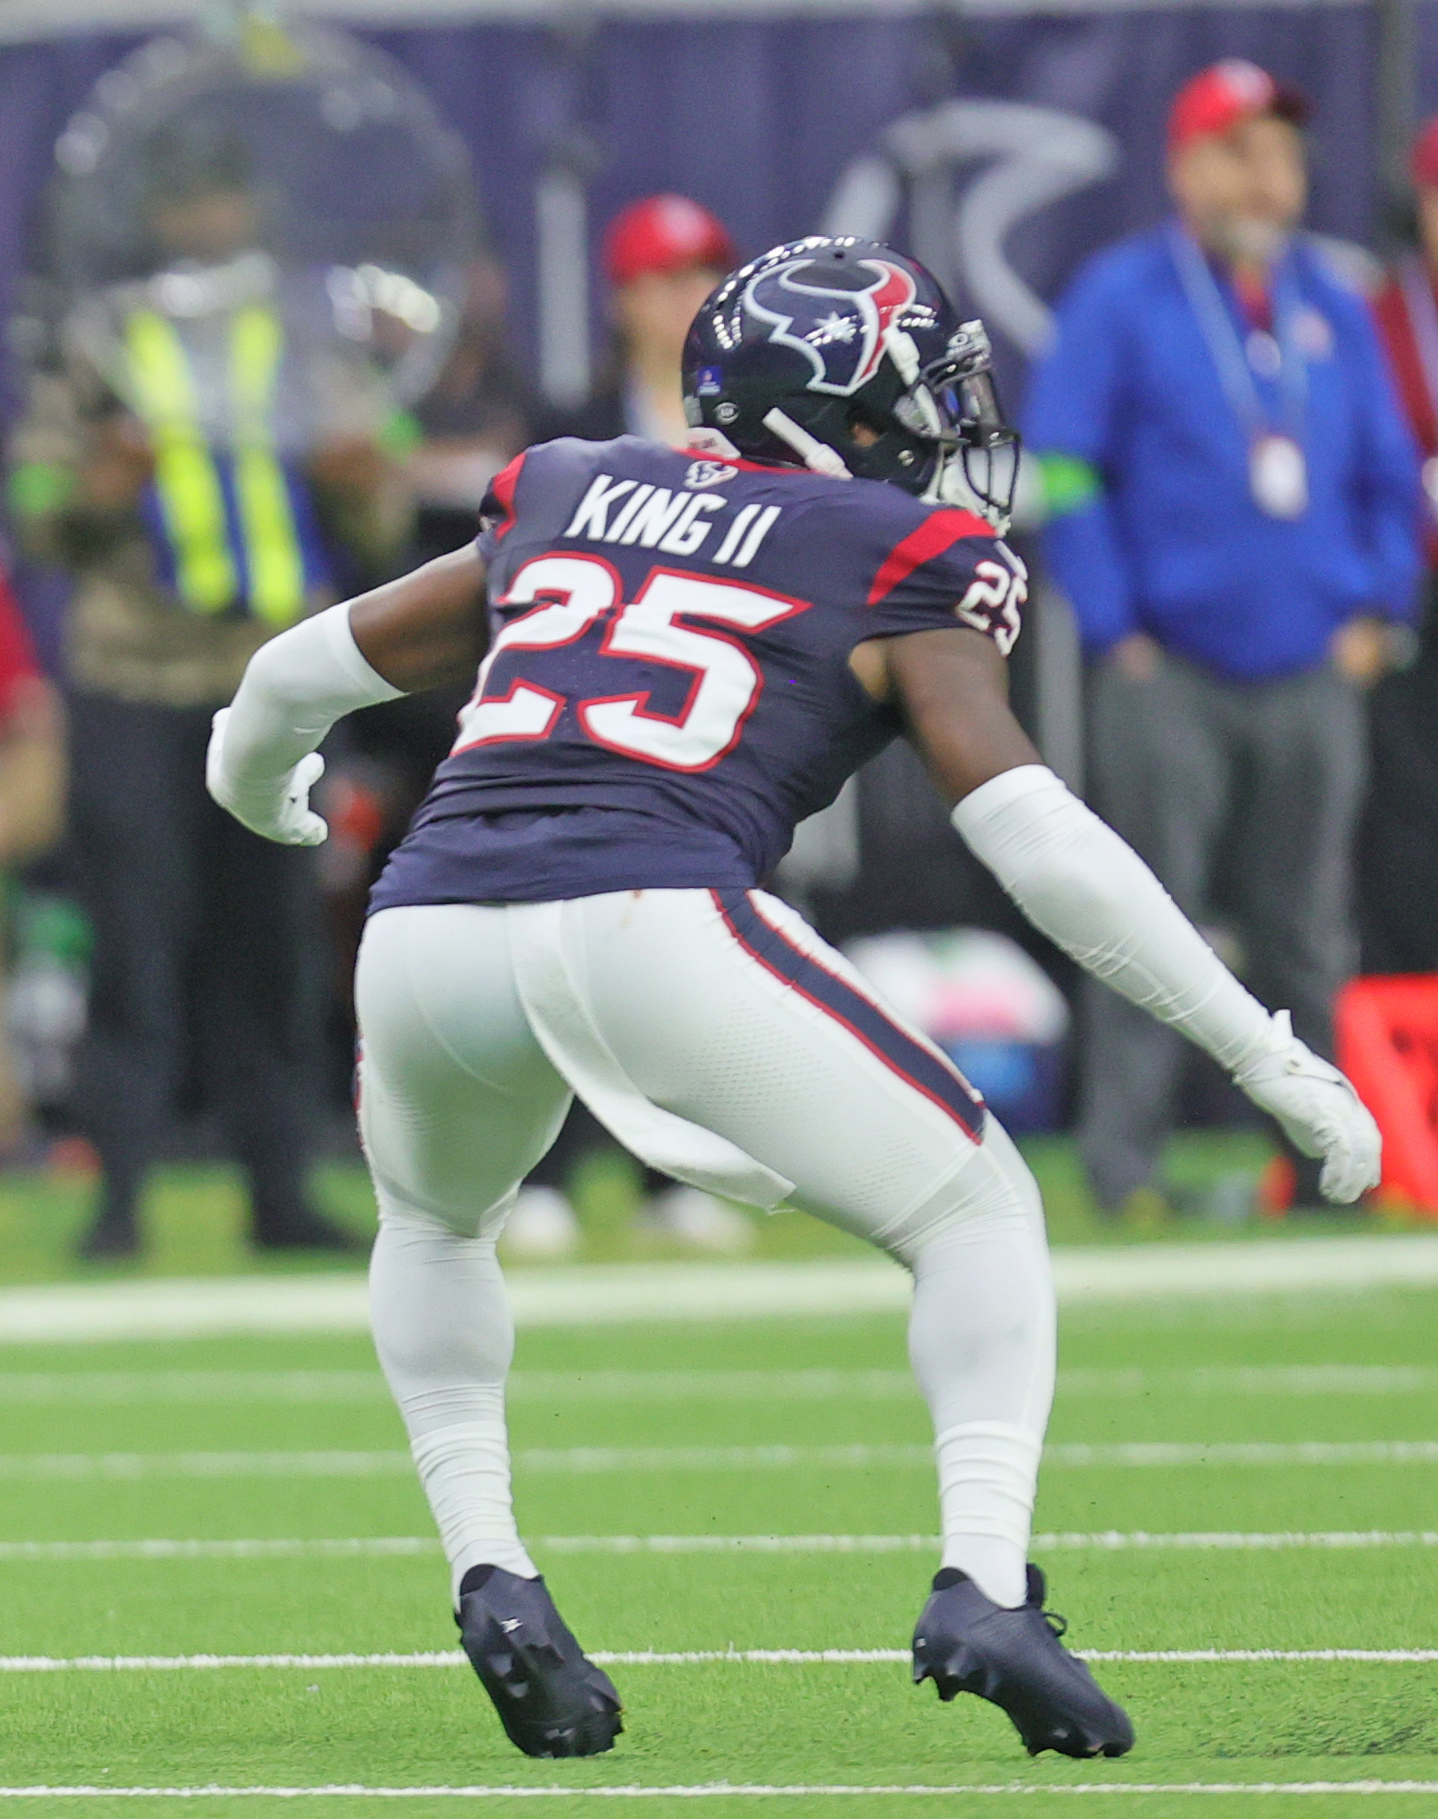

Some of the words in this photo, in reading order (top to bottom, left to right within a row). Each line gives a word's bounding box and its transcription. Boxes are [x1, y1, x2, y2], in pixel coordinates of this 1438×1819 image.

[563, 474, 727, 556] KING
[712, 504, 781, 568] II
[954, 559, 1028, 657] 25
[450, 551, 812, 772] 25
